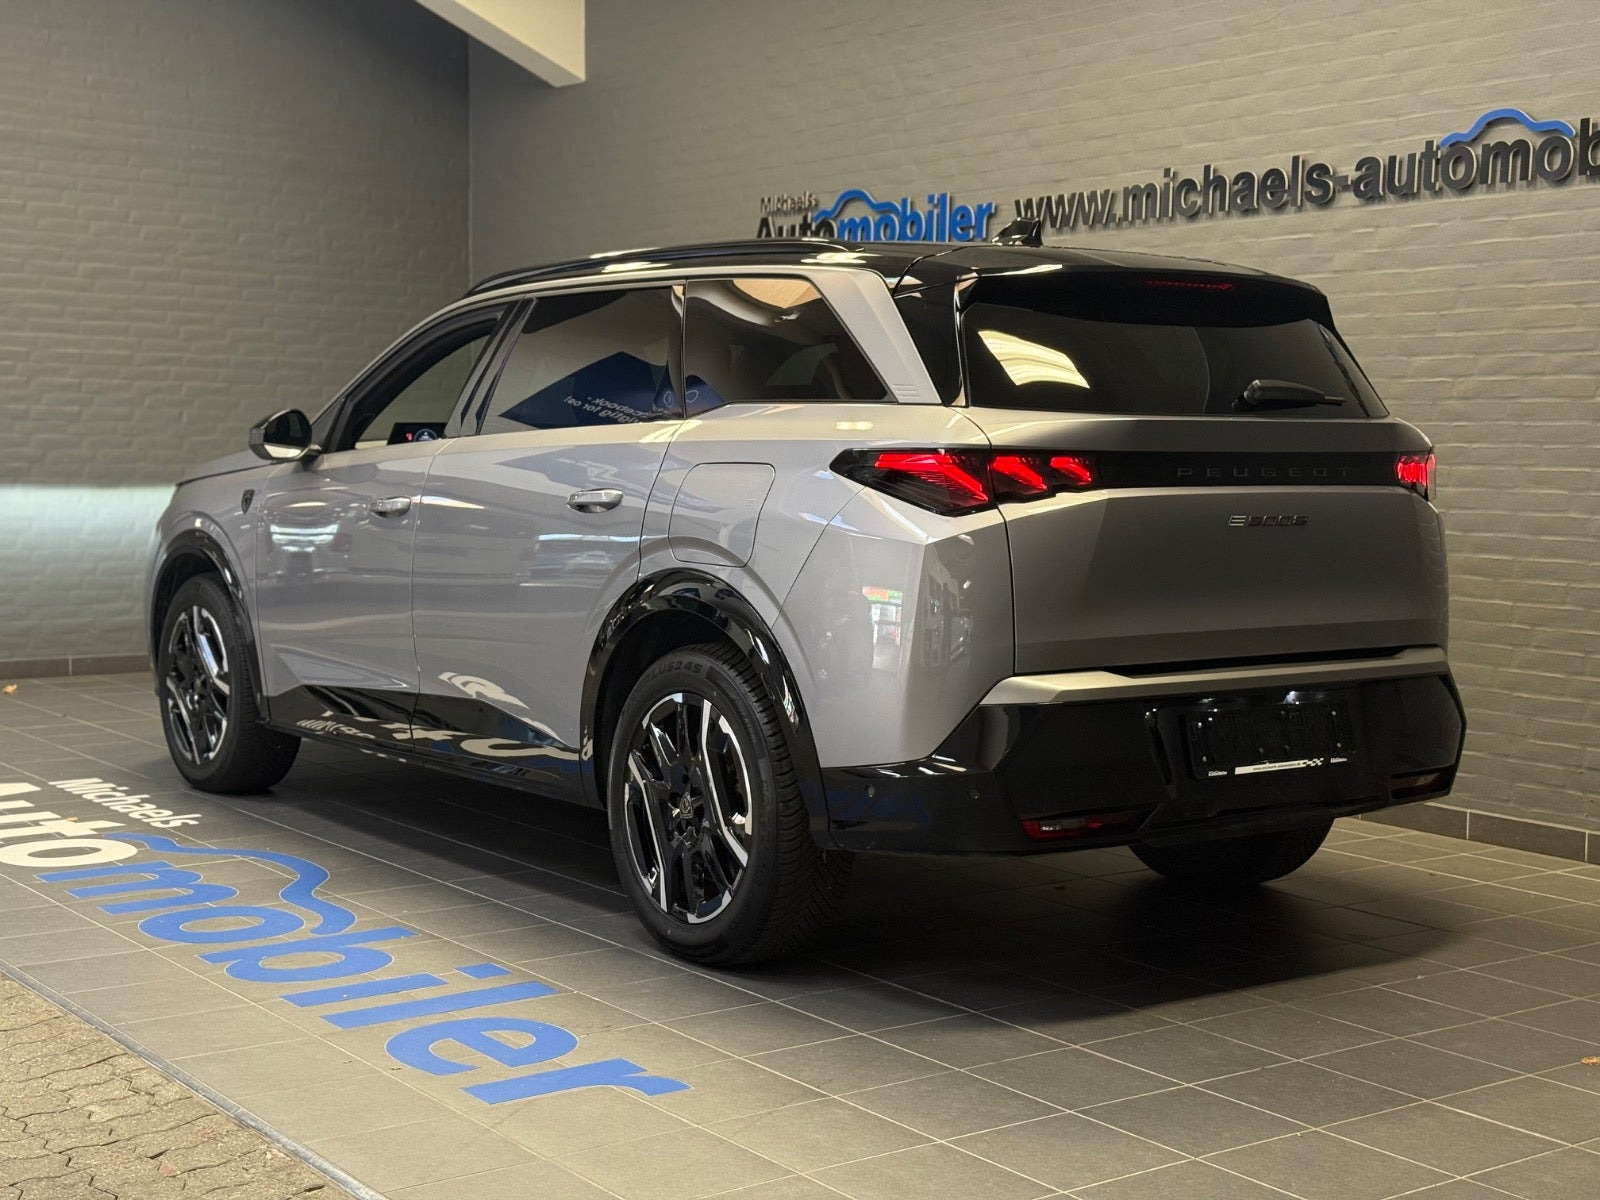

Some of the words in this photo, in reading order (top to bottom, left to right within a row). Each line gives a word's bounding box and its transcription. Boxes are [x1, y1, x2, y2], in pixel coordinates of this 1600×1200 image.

[1176, 466, 1350, 478] PEUGEOT
[48, 778, 202, 828] Michaels
[0, 782, 694, 1105] tomobiler
